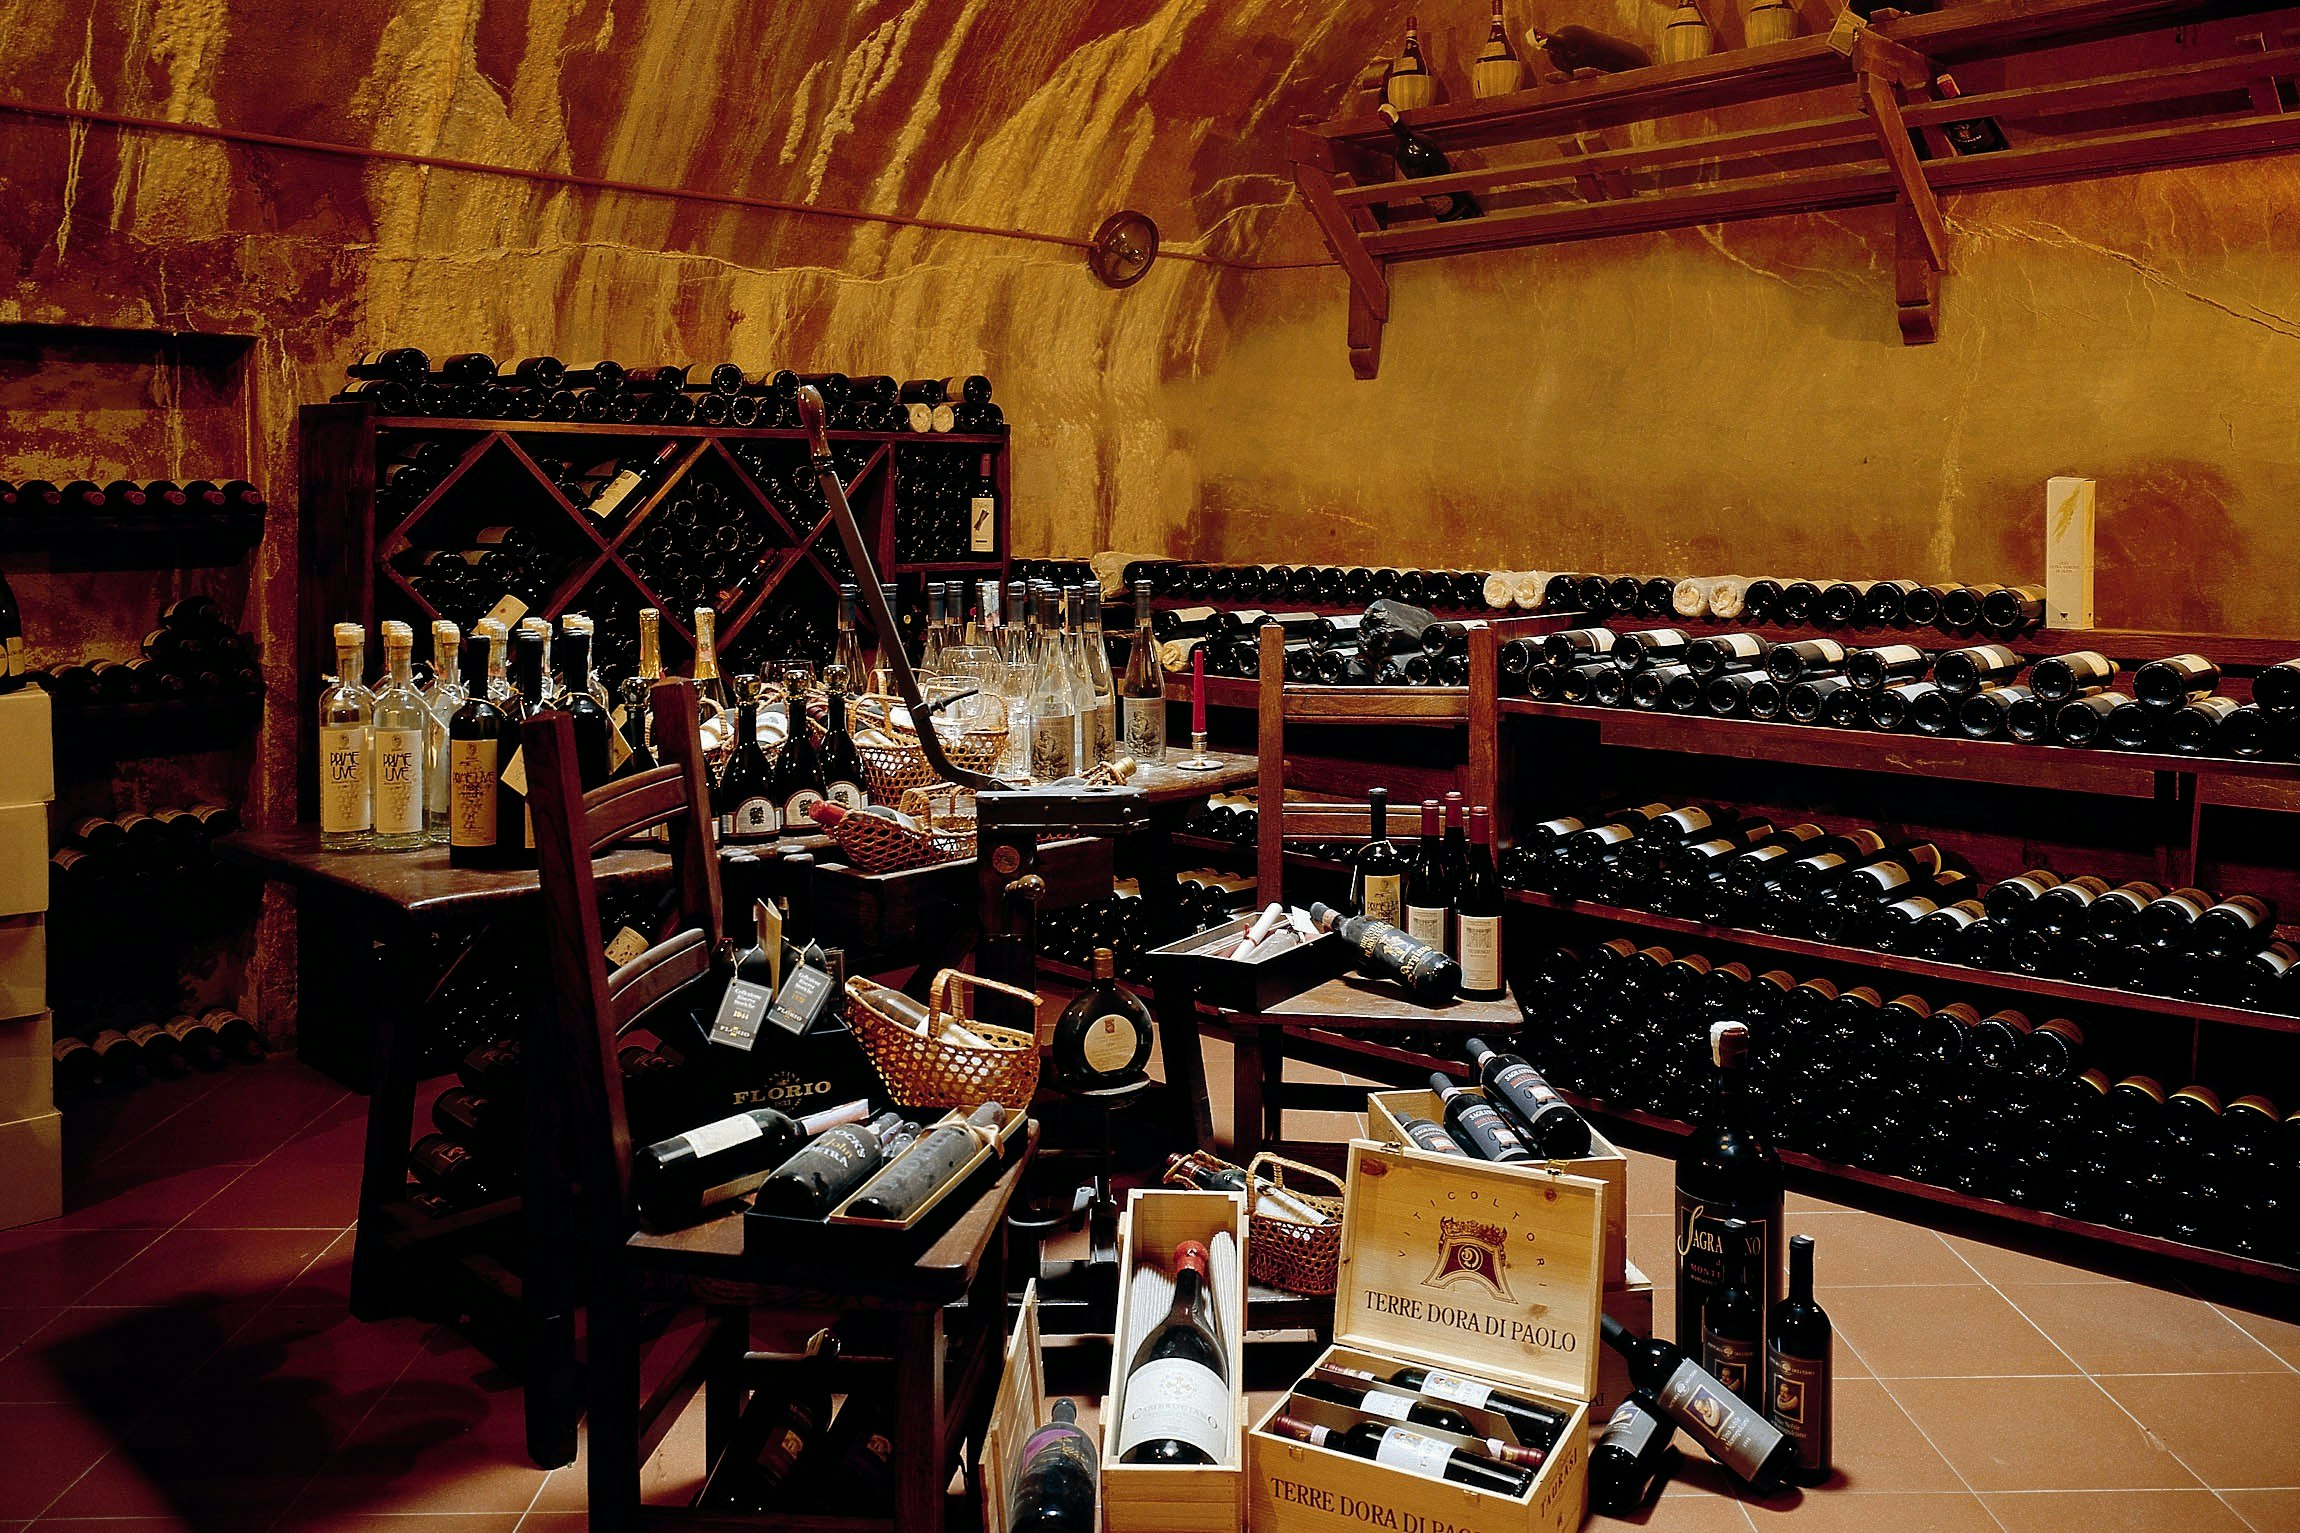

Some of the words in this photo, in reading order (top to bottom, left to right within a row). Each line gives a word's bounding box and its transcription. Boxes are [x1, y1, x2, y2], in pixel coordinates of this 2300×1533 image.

[719, 1025, 750, 1038] FLORIO
[732, 1080, 832, 1105] FLORIO
[1397, 1190, 1548, 1288] VITICOLTORI
[1364, 1290, 1423, 1320] TERRE
[1427, 1303, 1480, 1333] DORA
[1485, 1315, 1506, 1338] DI
[1511, 1321, 1577, 1352] PAOLO
[1270, 1477, 1335, 1513] TERRE
[1339, 1495, 1398, 1530] DORA
[1403, 1512, 1426, 1533] DI
